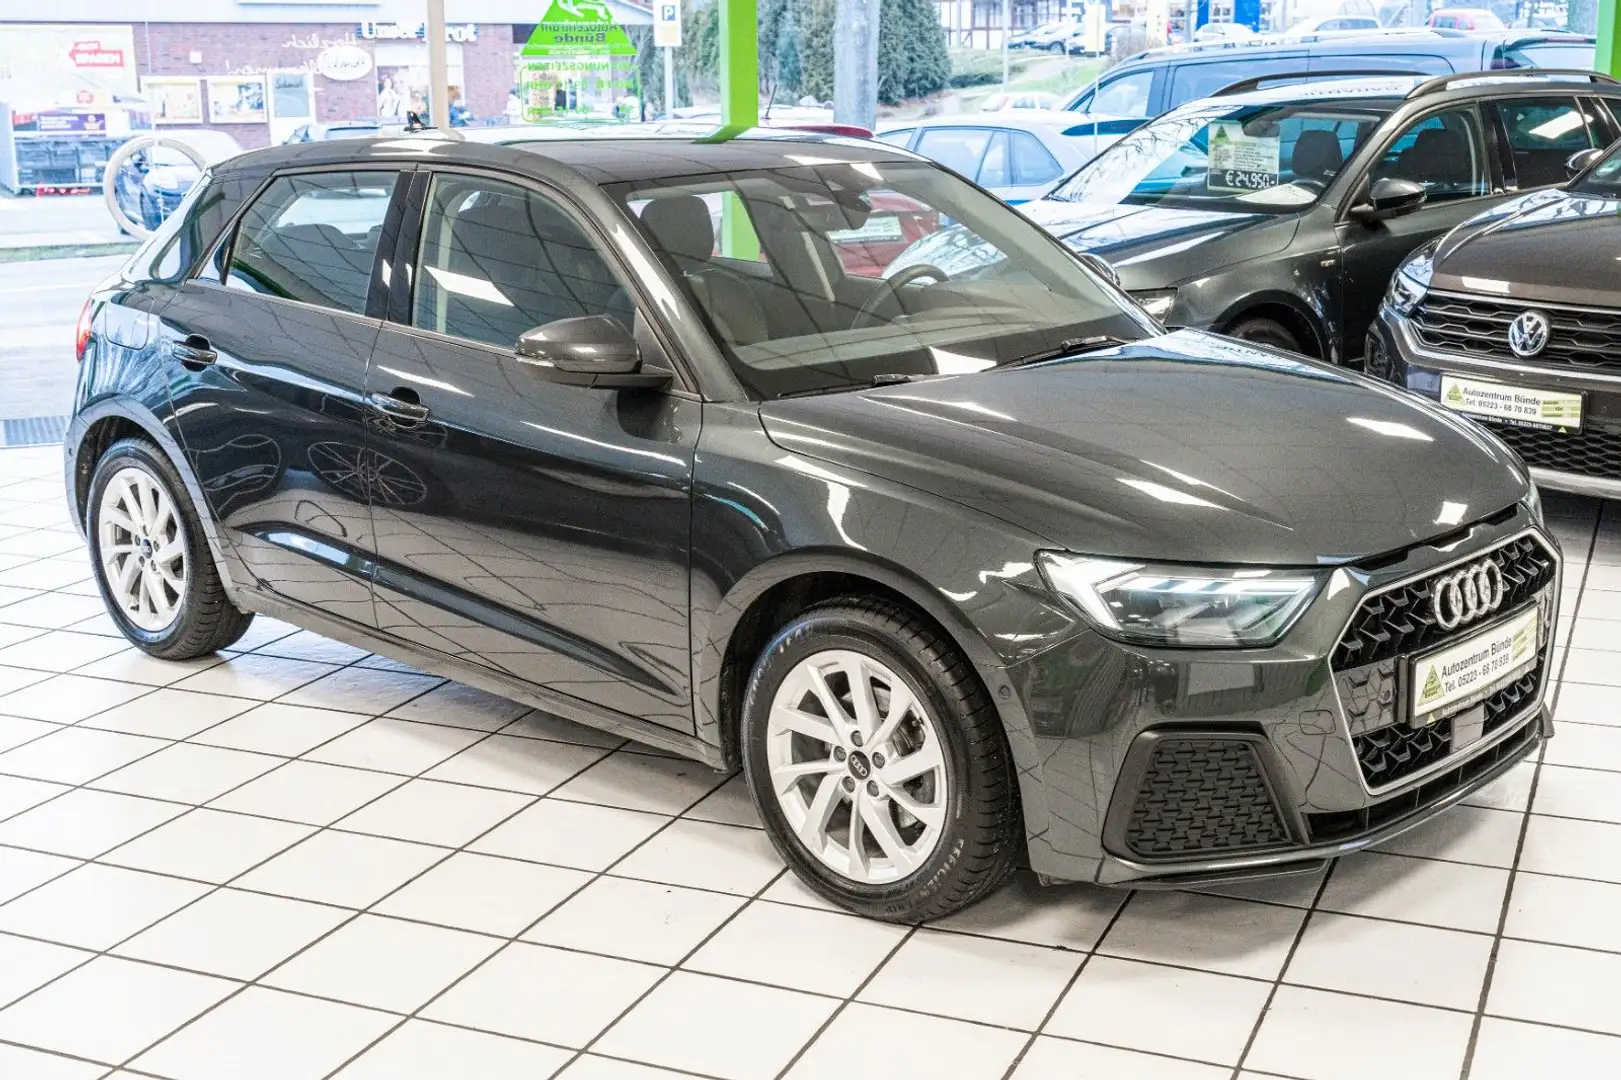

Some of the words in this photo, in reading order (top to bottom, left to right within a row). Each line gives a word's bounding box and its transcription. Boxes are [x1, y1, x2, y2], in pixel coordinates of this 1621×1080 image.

[663, 6, 674, 20] P
[1463, 387, 1512, 402] Autozentrum
[1514, 394, 1541, 406] Bünde
[1478, 399, 1498, 410] 05223
[1503, 403, 1512, 412] 68
[1514, 405, 1522, 414] 70
[1523, 406, 1537, 415] 839
[1441, 649, 1490, 678] Autozentrum
[1491, 636, 1512, 656] Bünde
[1445, 680, 1456, 693] Tel.
[1457, 669, 1478, 688] 05223
[1482, 663, 1490, 676] 68
